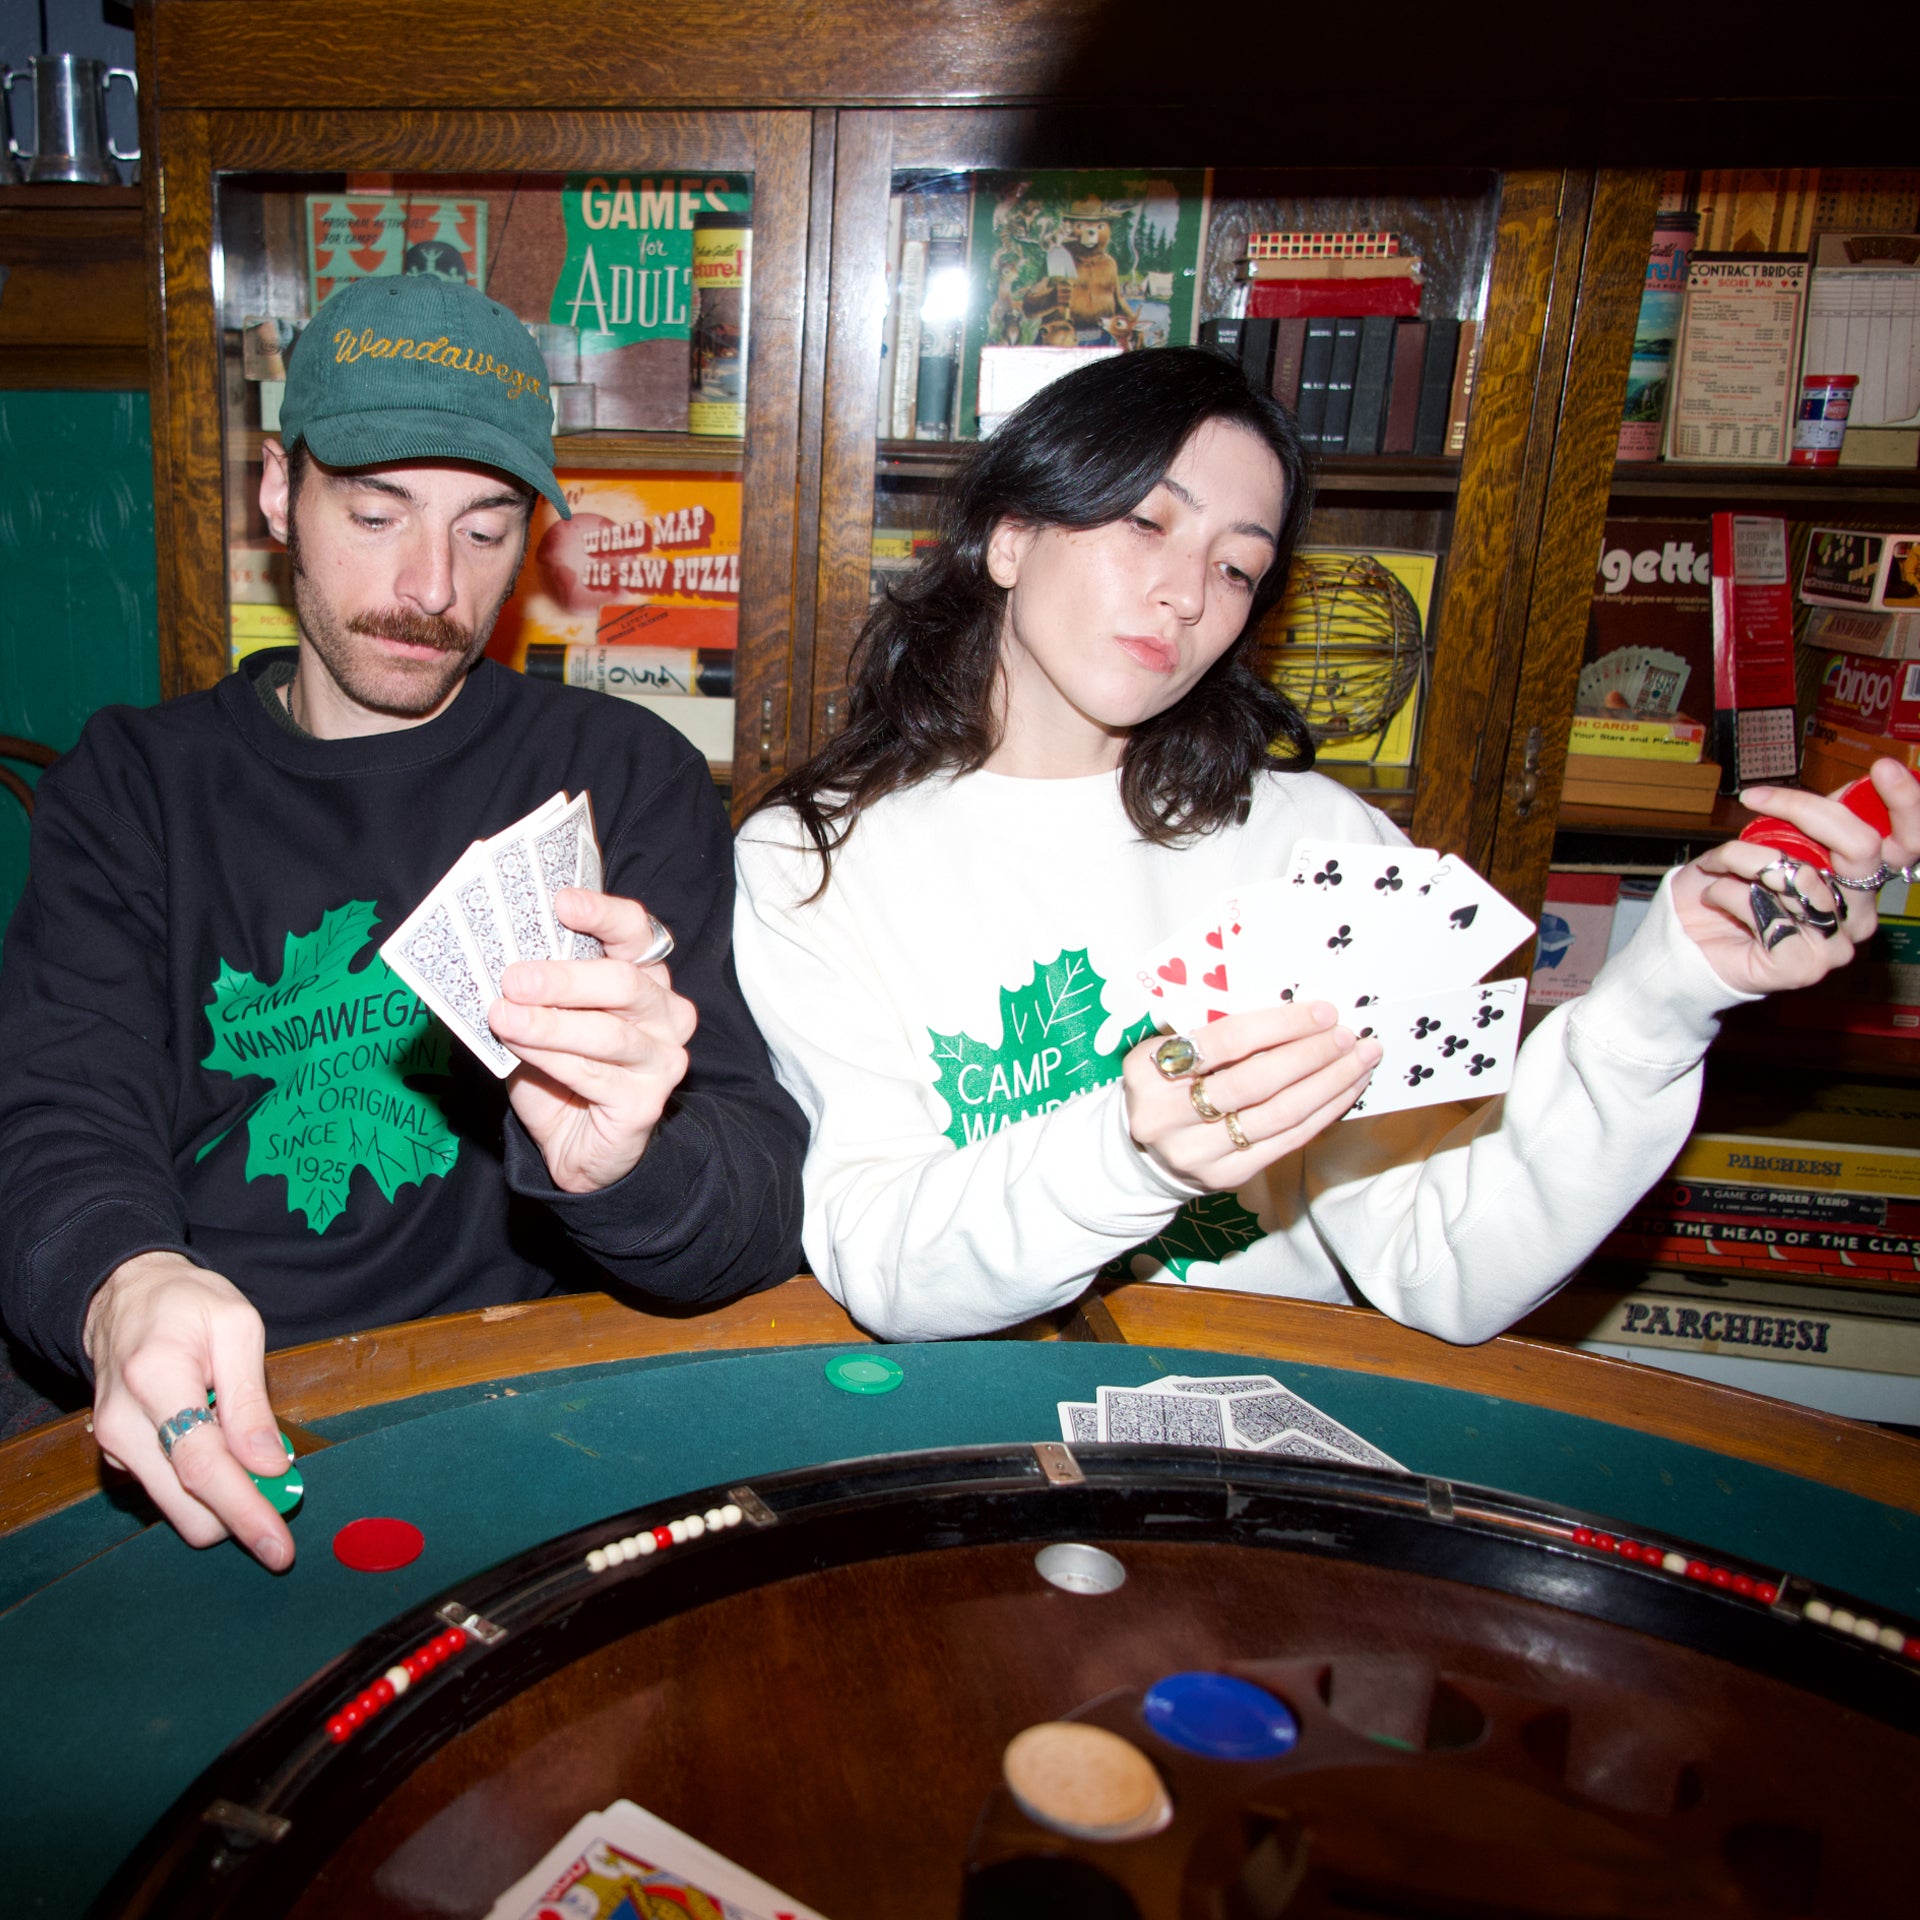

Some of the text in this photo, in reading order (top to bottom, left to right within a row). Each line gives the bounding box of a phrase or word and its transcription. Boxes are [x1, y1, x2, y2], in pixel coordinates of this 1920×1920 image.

[582, 177, 729, 230] GAMES
[322, 217, 370, 228] PROGRAM
[322, 233, 342, 245] FOR
[639, 233, 668, 265] for
[1689, 264, 1804, 278] CONTRACT BRIDGE
[1717, 278, 1773, 288] SCORE PAD
[334, 328, 549, 405] Wandawega
[583, 506, 705, 553] WORLD MAP
[582, 559, 667, 589] JIG-SAW
[1835, 656, 1892, 716] bingo
[1593, 721, 1639, 731] CARDS
[1600, 732, 1624, 741] Stars
[1630, 735, 1648, 743] and
[222, 974, 320, 1023] CAMP
[223, 989, 431, 1062] WANDAWEGA
[286, 1037, 438, 1100] WISCONSIN
[957, 1047, 1062, 1105] CAMP
[319, 1086, 429, 1137] ORIGINAL
[266, 1121, 338, 1160] SINCE
[296, 1157, 348, 1184] 1925
[1728, 1153, 1842, 1177] PARCHEESI
[1702, 1189, 1710, 1197] A
[1714, 1190, 1747, 1200] GAME
[1751, 1192, 1766, 1202] OF
[1674, 1222, 1713, 1237] THE
[1722, 1227, 1777, 1242] HEAD
[1785, 1232, 1810, 1244] OF
[1820, 1235, 1859, 1249] THE
[1621, 1303, 1830, 1353] PARCHEESI
